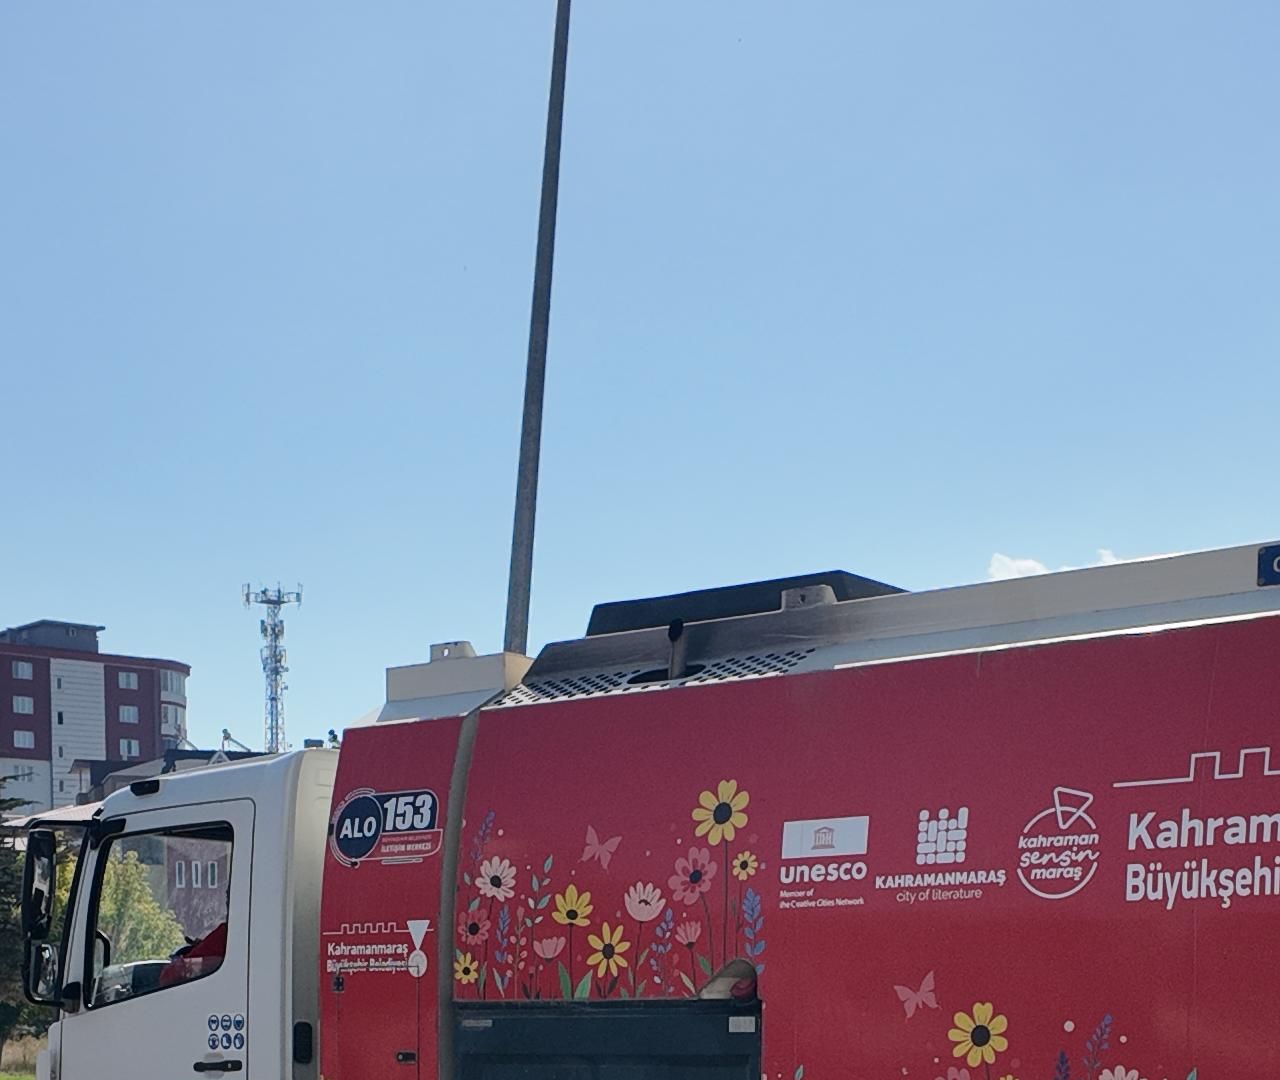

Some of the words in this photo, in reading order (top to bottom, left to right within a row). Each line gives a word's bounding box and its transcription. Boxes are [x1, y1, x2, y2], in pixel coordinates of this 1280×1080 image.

[383, 794, 433, 831] 153
[339, 816, 377, 839] ALO
[1018, 833, 1099, 849] kahraman
[780, 862, 868, 884] unesco
[875, 869, 1007, 889] KAHRAMANMARAŞ
[1030, 866, 1083, 881] maraş
[806, 888, 815, 897] of
[896, 891, 916, 905] city
[918, 890, 930, 902] of
[931, 888, 983, 901] literature
[327, 942, 409, 958] Kahramanmaraş
